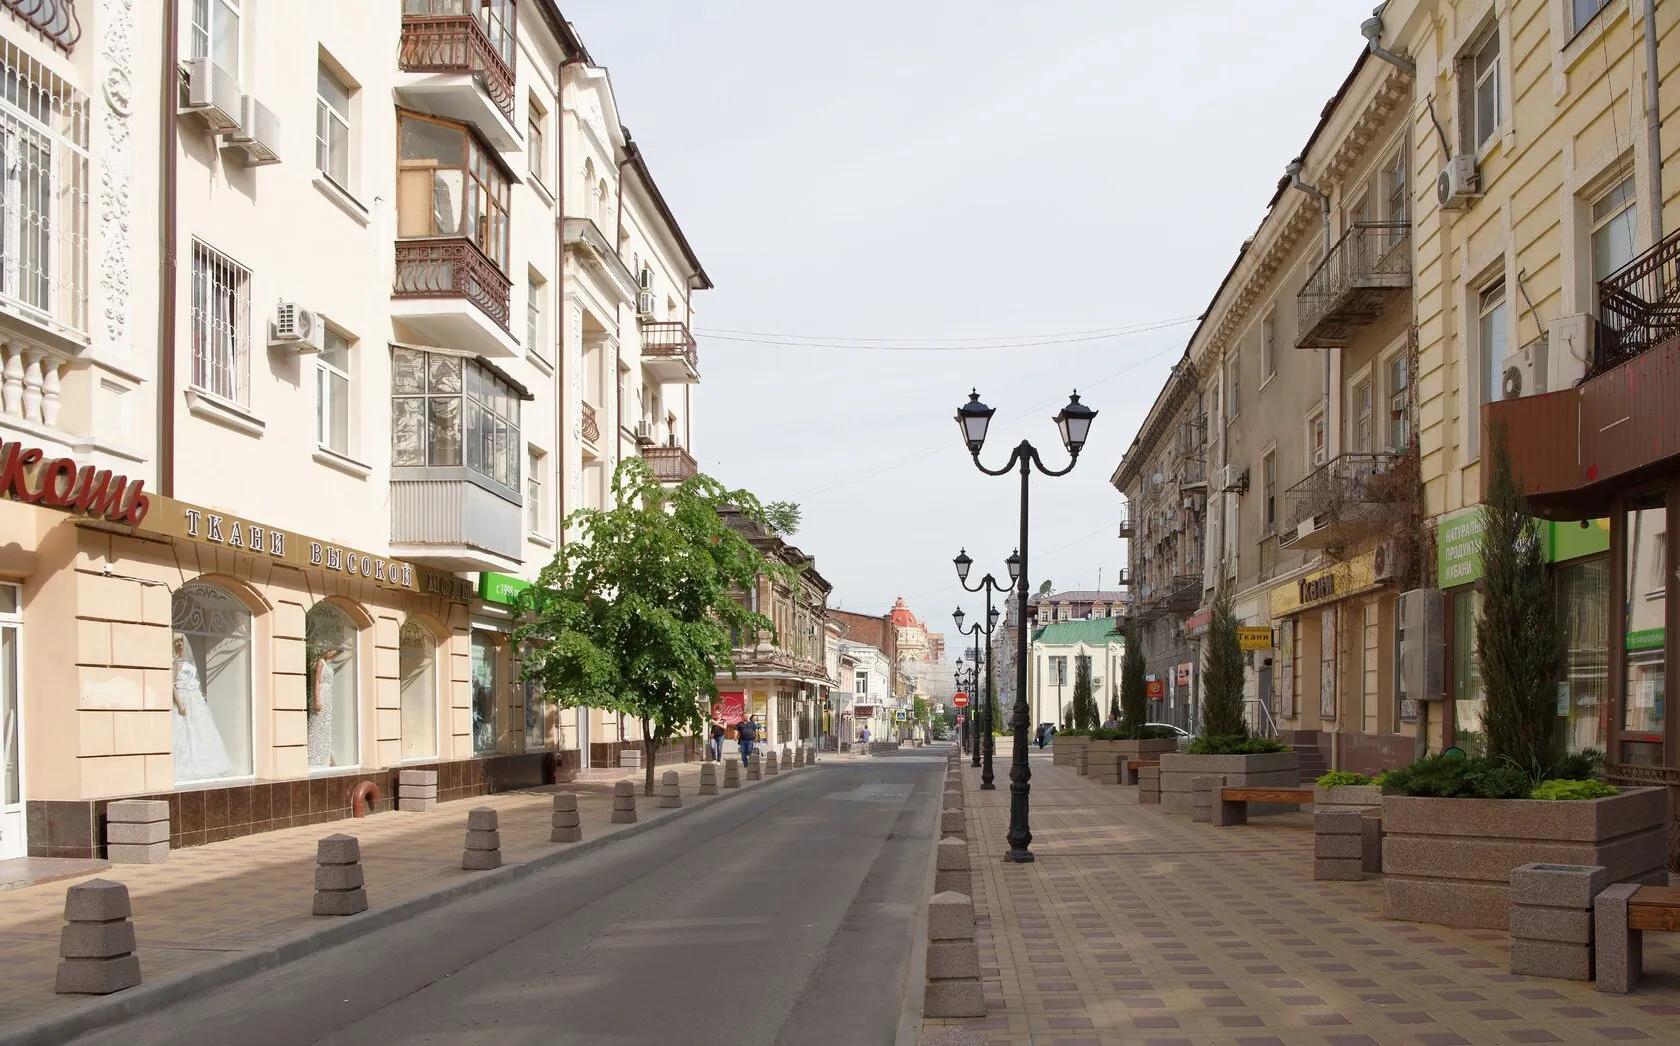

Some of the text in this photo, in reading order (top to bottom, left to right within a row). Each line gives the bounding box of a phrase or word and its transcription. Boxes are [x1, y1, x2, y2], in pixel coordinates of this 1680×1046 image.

[0, 436, 150, 525] кошь
[186, 508, 473, 601] ТКАНИ ВЫСОКОЙ МОДЫ
[1446, 561, 1472, 580] КУБАНИ
[1297, 573, 1335, 604] Ткани
